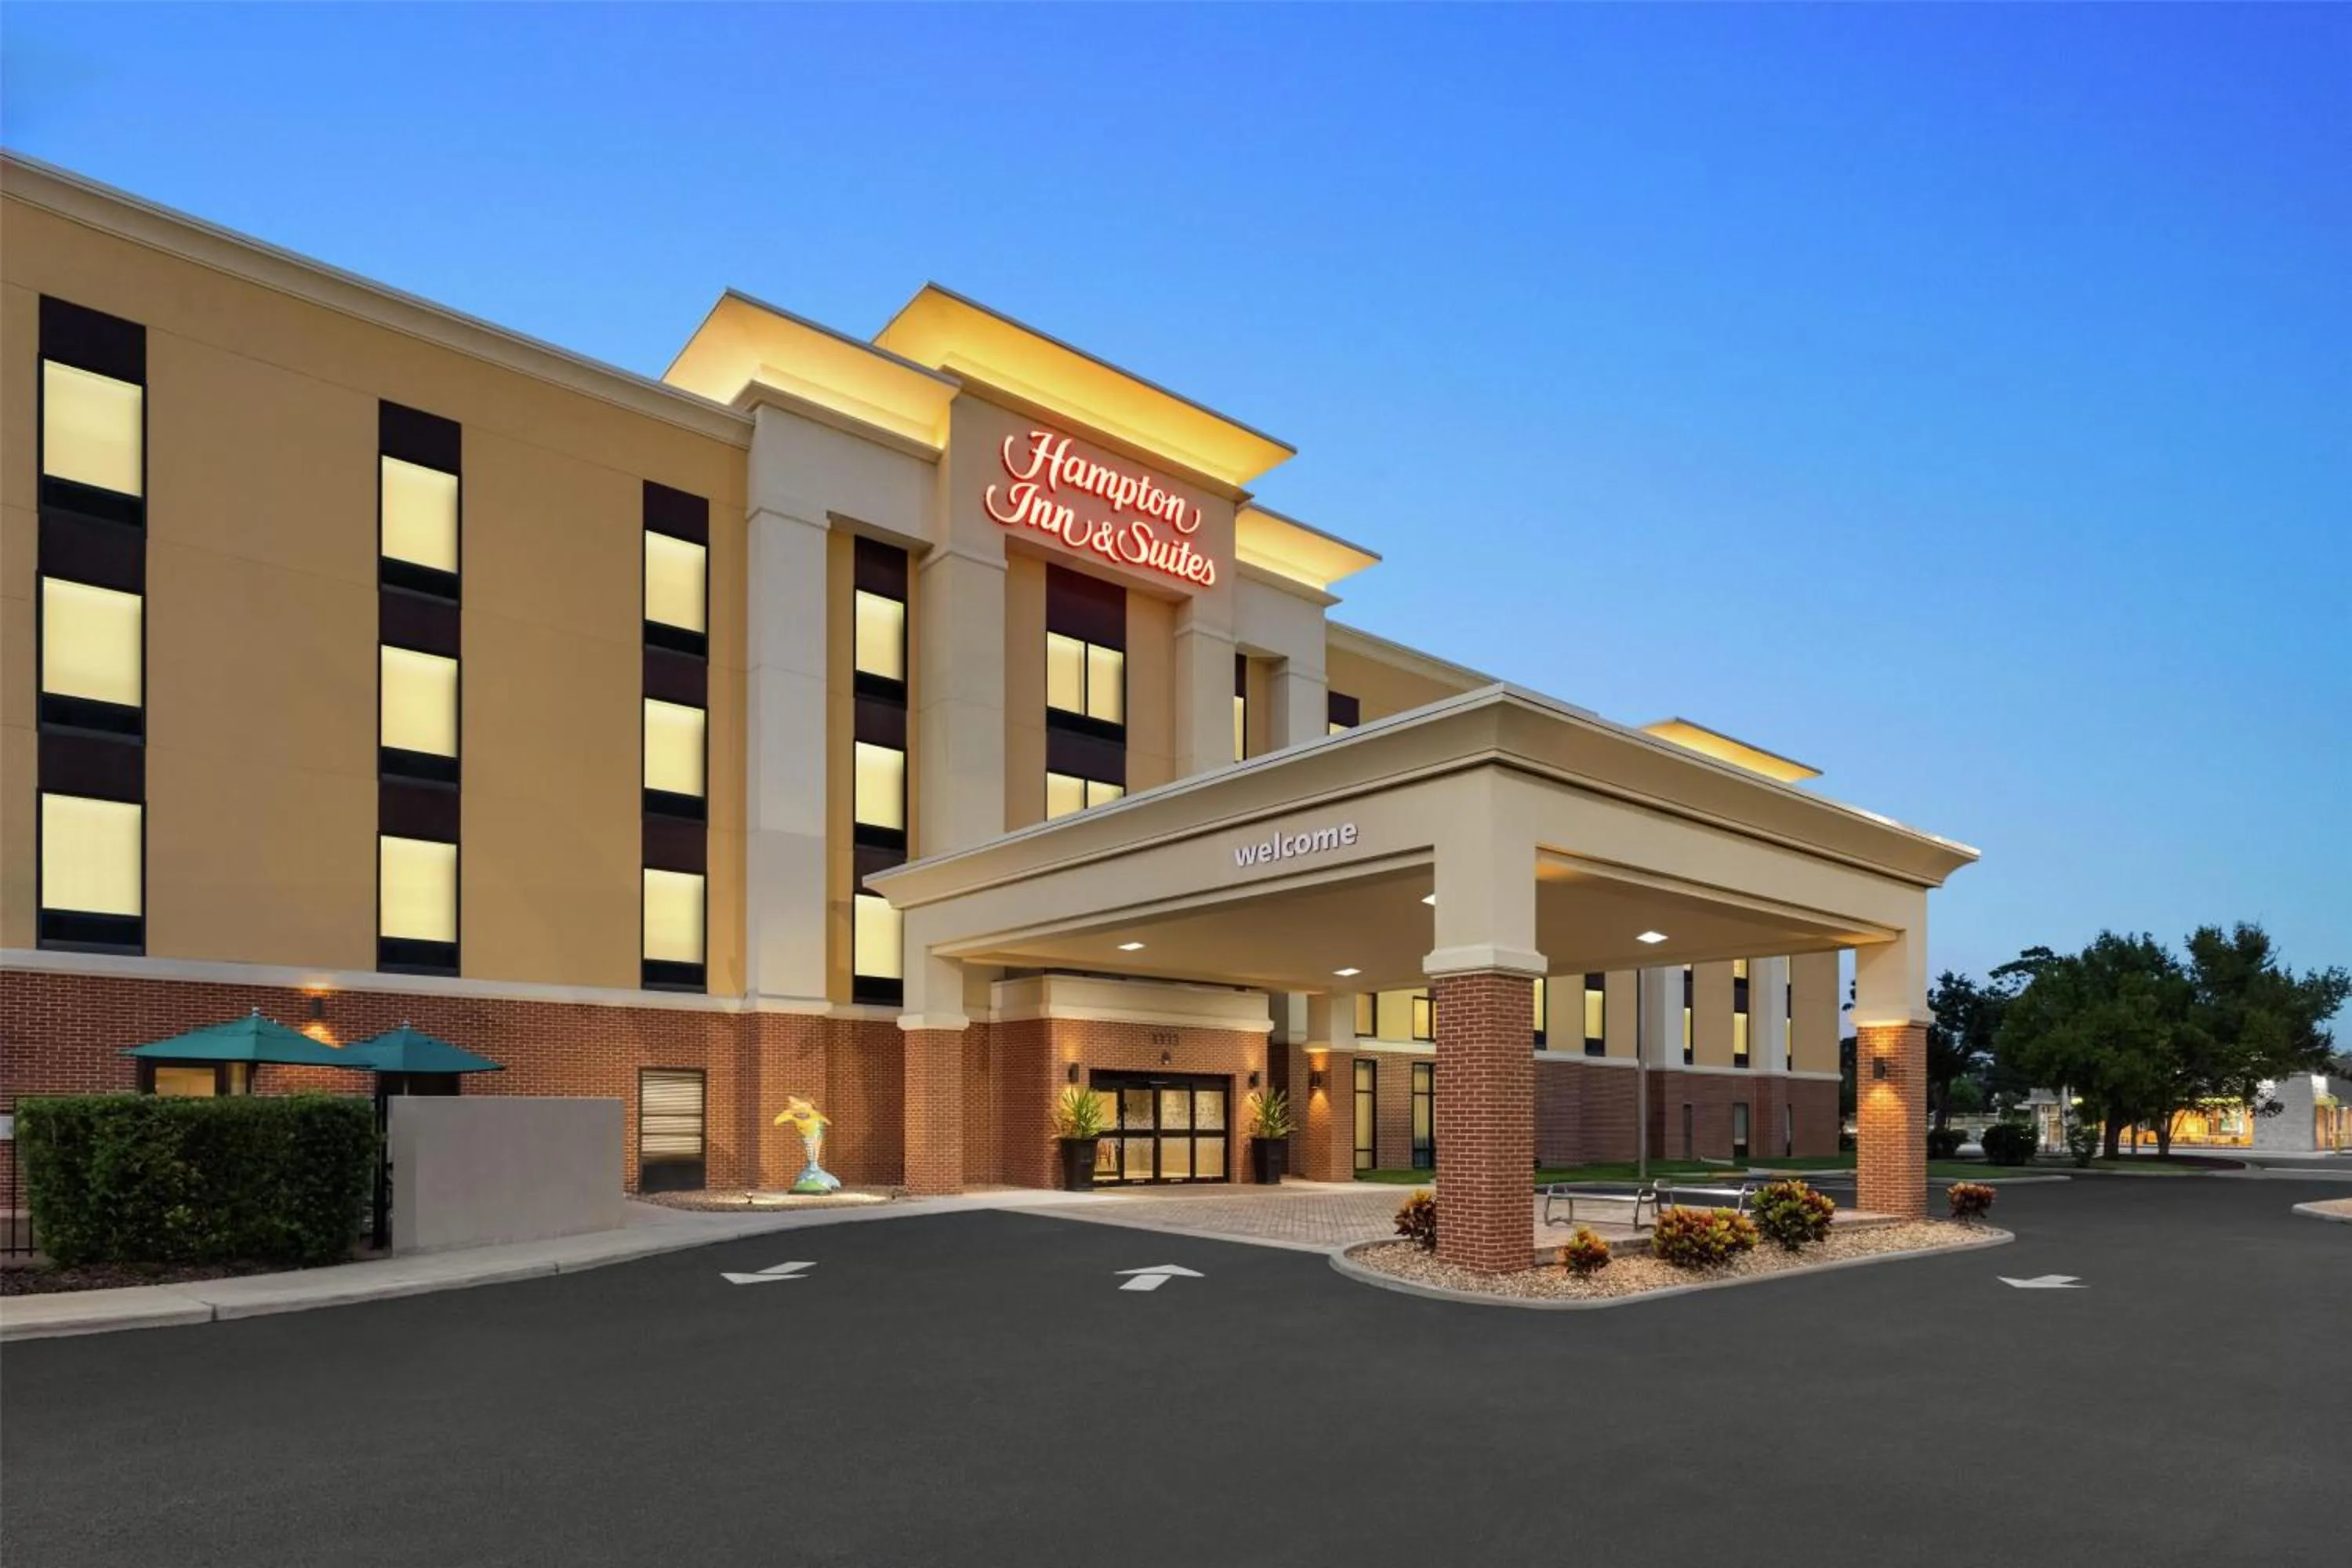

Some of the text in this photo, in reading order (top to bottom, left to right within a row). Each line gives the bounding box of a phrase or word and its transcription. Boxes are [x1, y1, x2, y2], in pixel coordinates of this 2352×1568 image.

[985, 482, 1092, 546] Inn
[1116, 521, 1216, 586] Suites
[1003, 430, 1201, 534] Hampton
[1234, 822, 1359, 867] welcome
